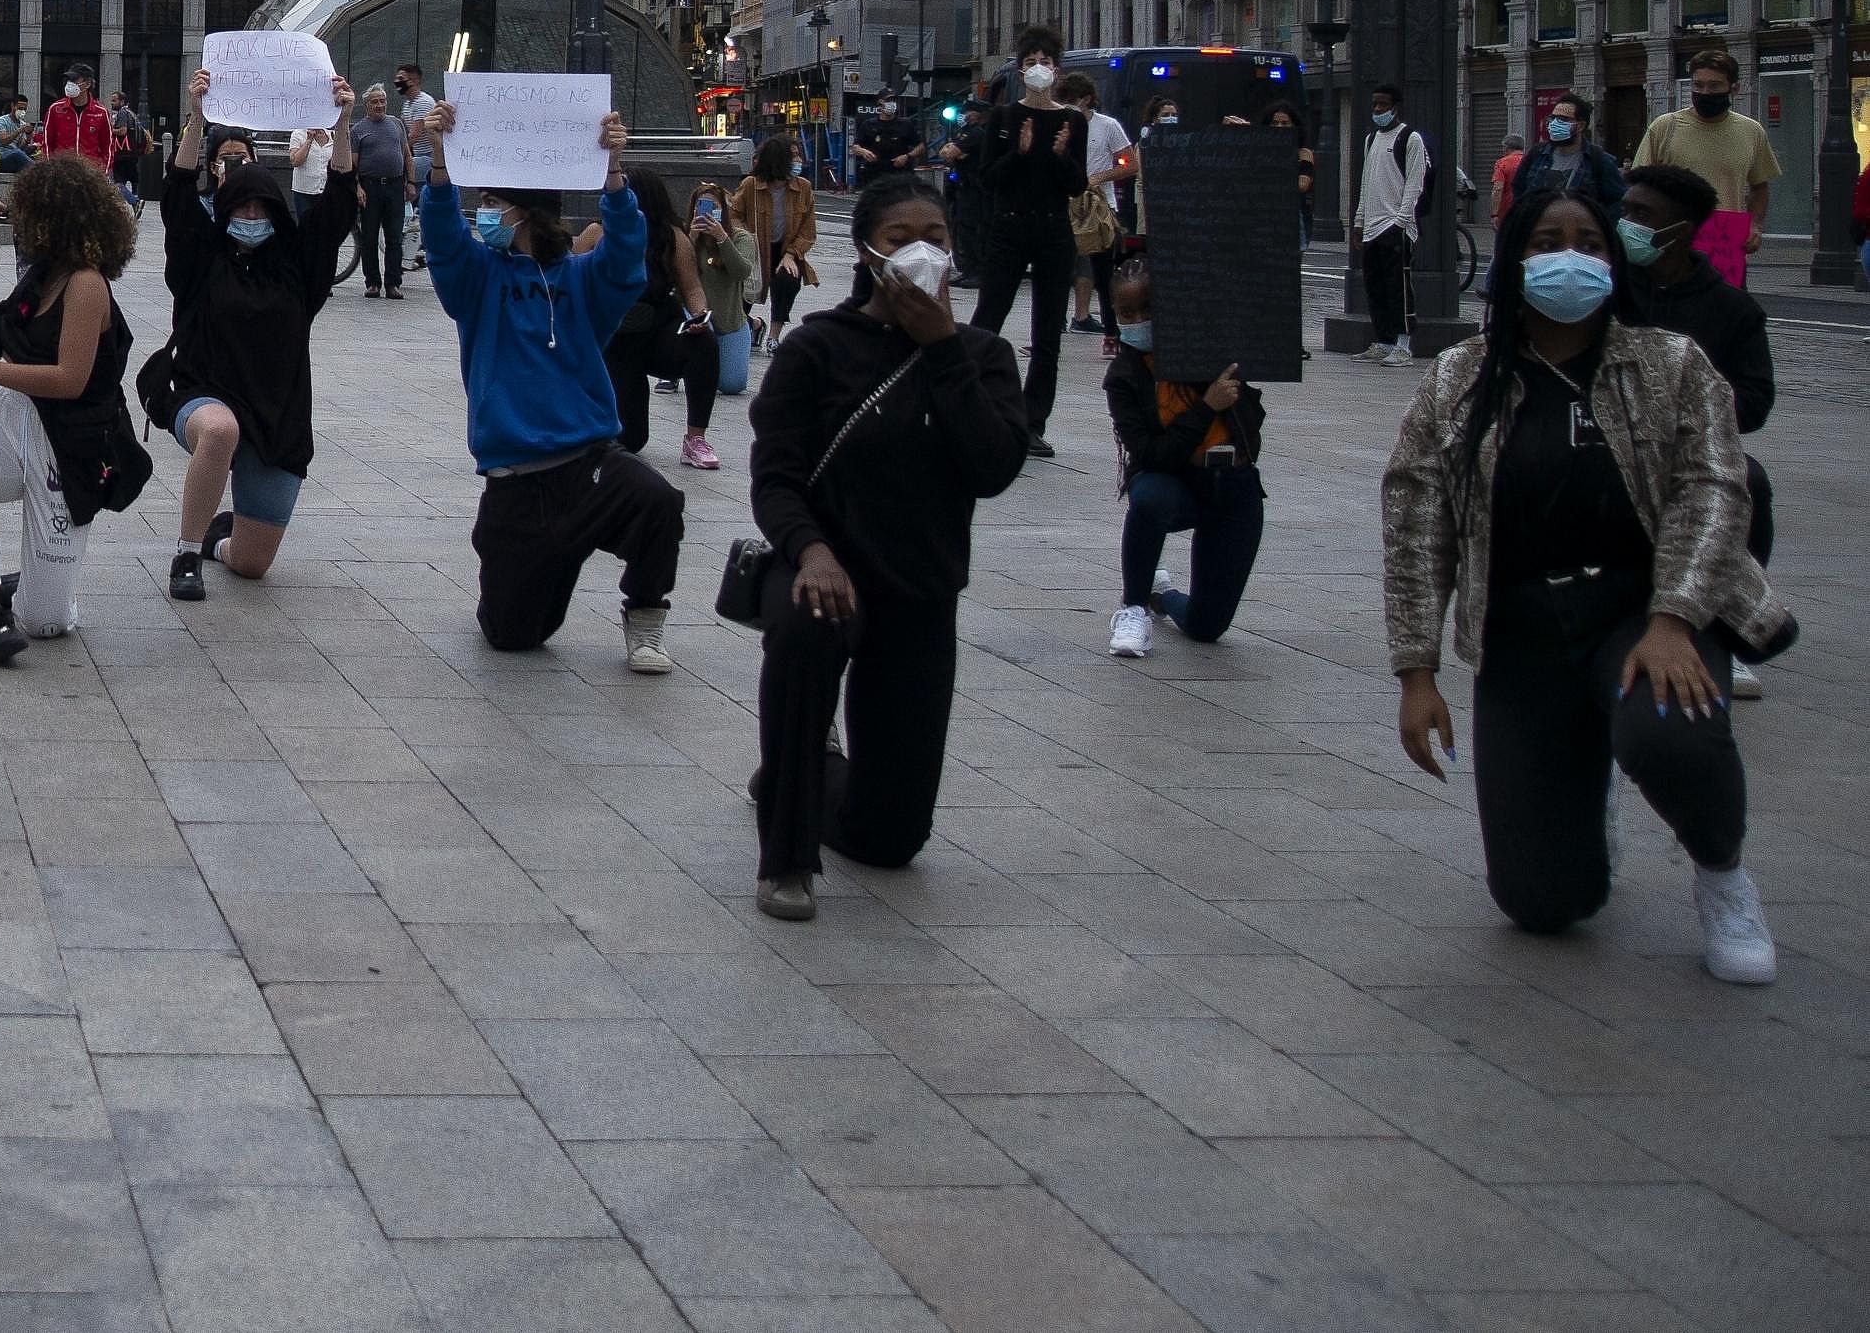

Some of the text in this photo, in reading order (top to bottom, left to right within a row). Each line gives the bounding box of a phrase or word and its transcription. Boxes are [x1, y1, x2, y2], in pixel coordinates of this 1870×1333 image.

[206, 36, 317, 66] BLACK LIVES
[1253, 54, 1282, 66] 1U-45
[457, 84, 593, 106] EL RACISMO NO
[205, 93, 312, 120] END OF TIME
[461, 119, 481, 134] ES
[493, 119, 527, 133] CADA
[512, 147, 537, 164] SE
